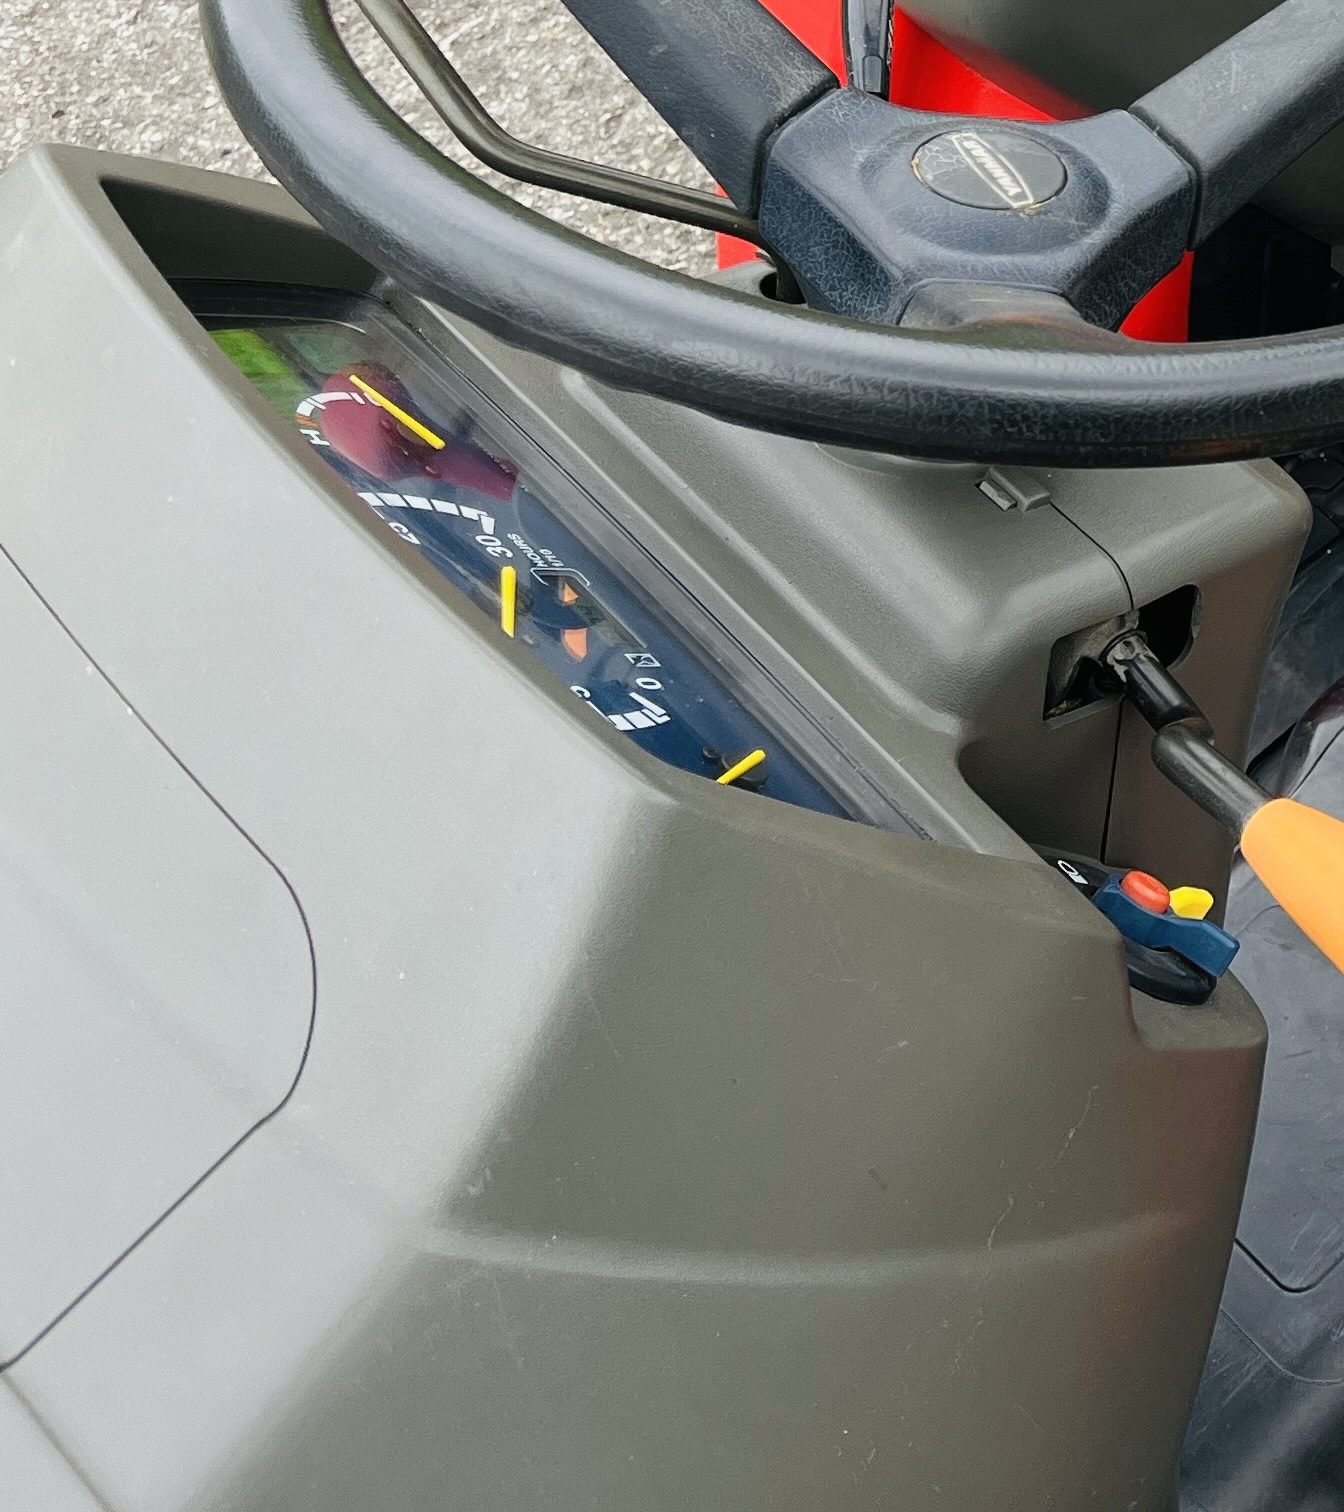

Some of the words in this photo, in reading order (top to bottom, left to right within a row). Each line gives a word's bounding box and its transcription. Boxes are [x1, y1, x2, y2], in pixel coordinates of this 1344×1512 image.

[299, 429, 330, 447] H
[474, 534, 514, 559] 30
[507, 534, 547, 568] HOURS
[539, 547, 565, 568] 1/10
[634, 676, 662, 691] 0
